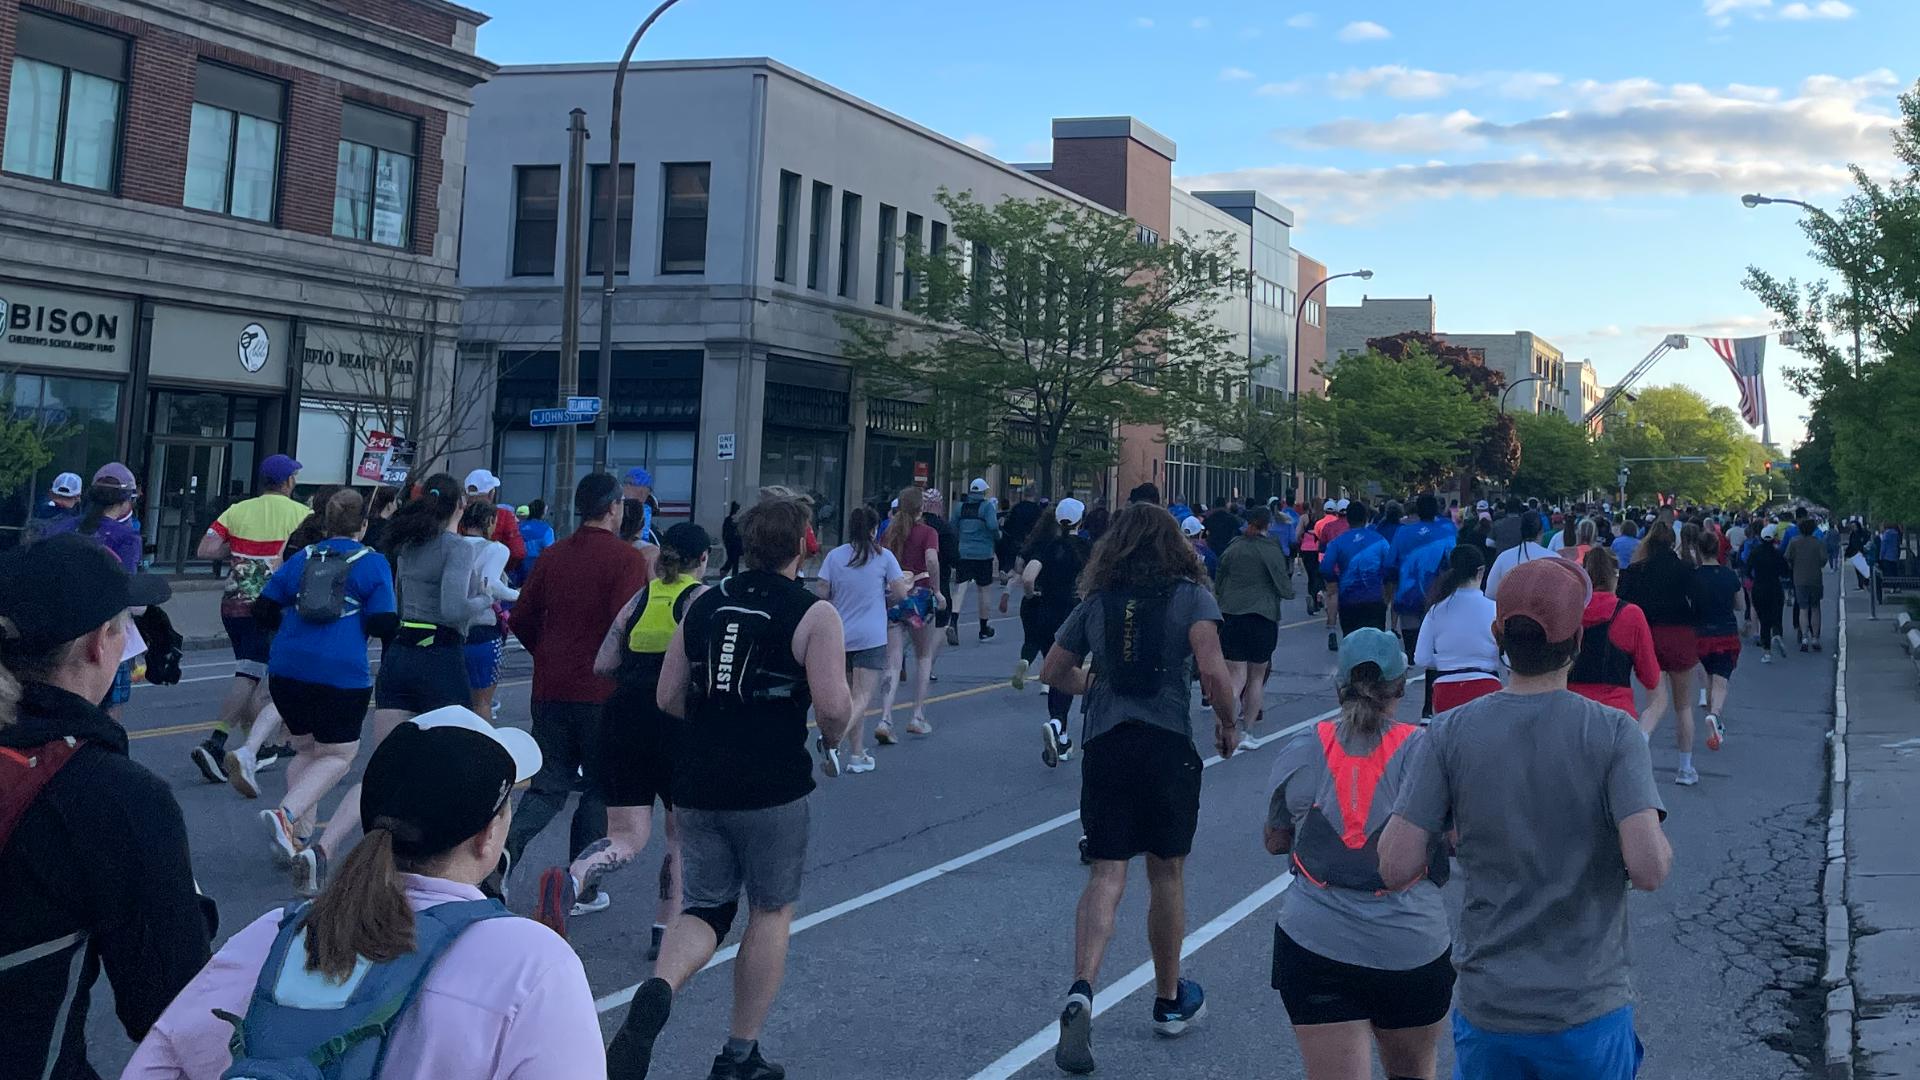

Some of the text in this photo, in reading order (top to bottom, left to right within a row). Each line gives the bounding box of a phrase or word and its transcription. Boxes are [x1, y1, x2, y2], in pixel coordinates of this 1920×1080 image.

[9, 303, 118, 340] BISON
[304, 348, 334, 366] BFLO
[391, 358, 413, 375] BAR
[540, 411, 582, 424] JOHNSON
[383, 471, 408, 482] 5:30
[1124, 599, 1137, 662] NATHAN
[716, 623, 739, 692] UTOBEST
